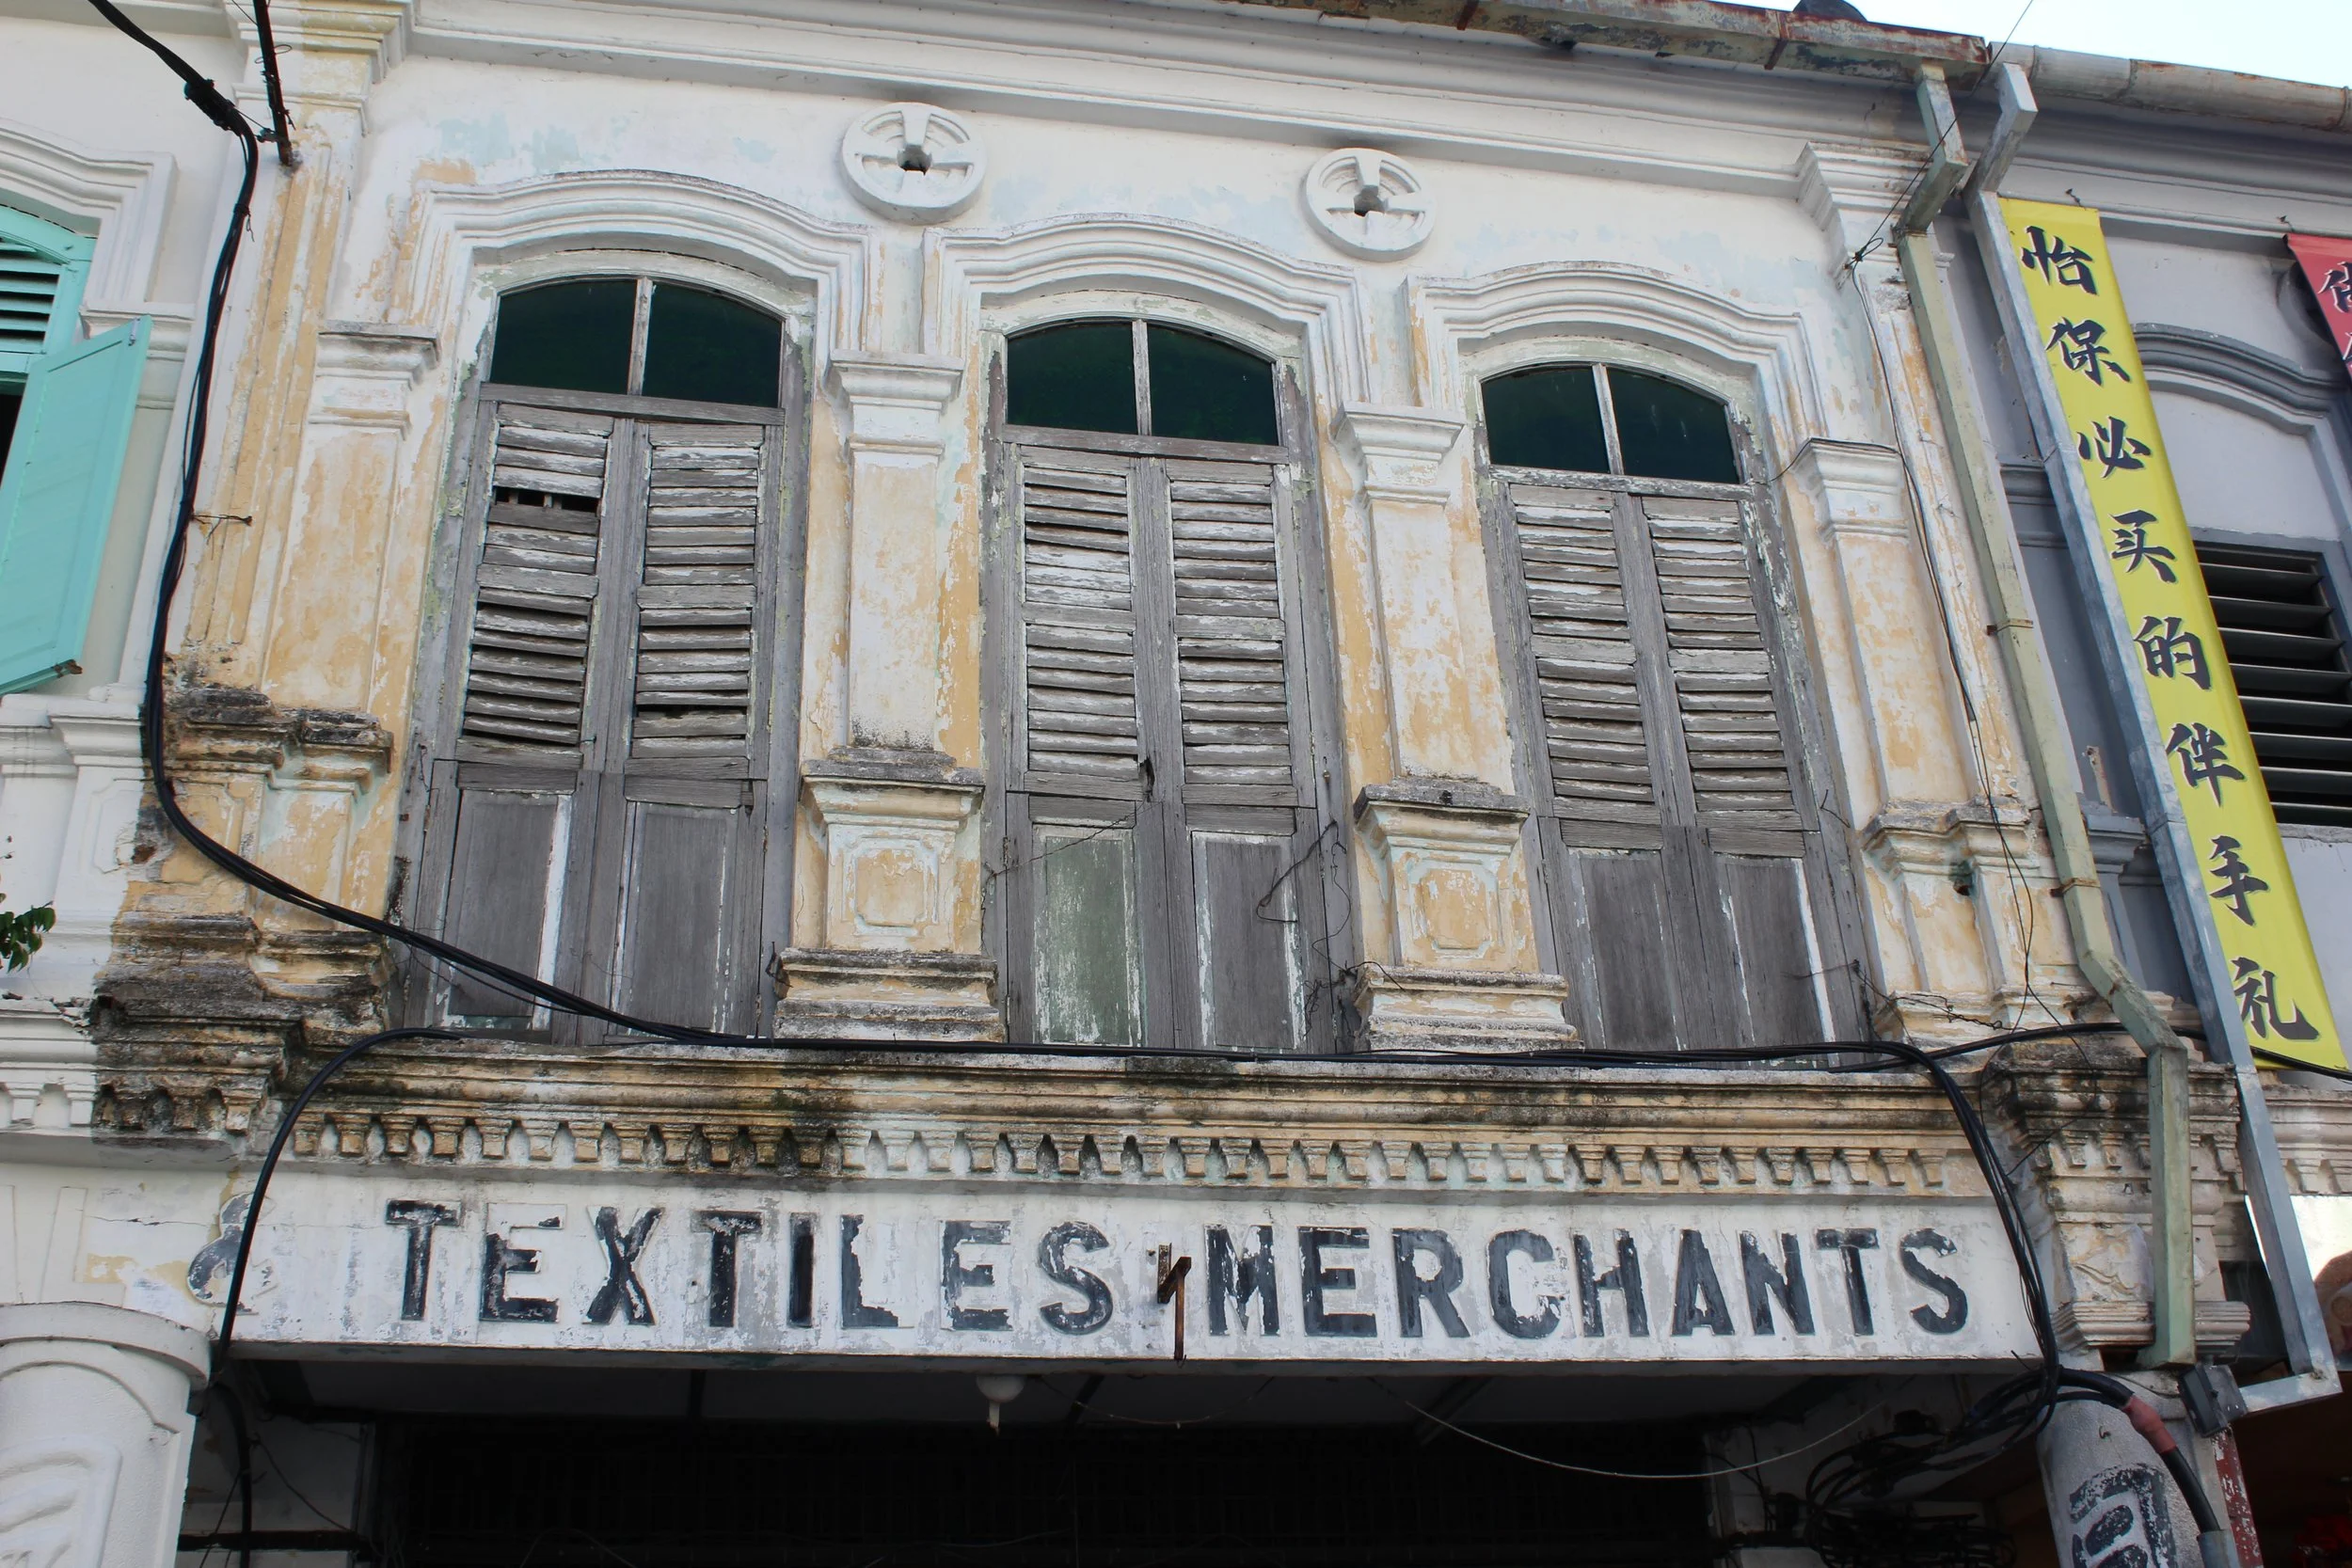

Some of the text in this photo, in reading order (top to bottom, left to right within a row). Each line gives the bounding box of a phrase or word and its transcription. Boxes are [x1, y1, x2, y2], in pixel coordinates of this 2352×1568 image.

[2020, 225, 2319, 1040] 怡保必买的伴手礼
[386, 1199, 1114, 1336] TEXTILES
[1203, 1223, 1968, 1339] MERCHANTS
